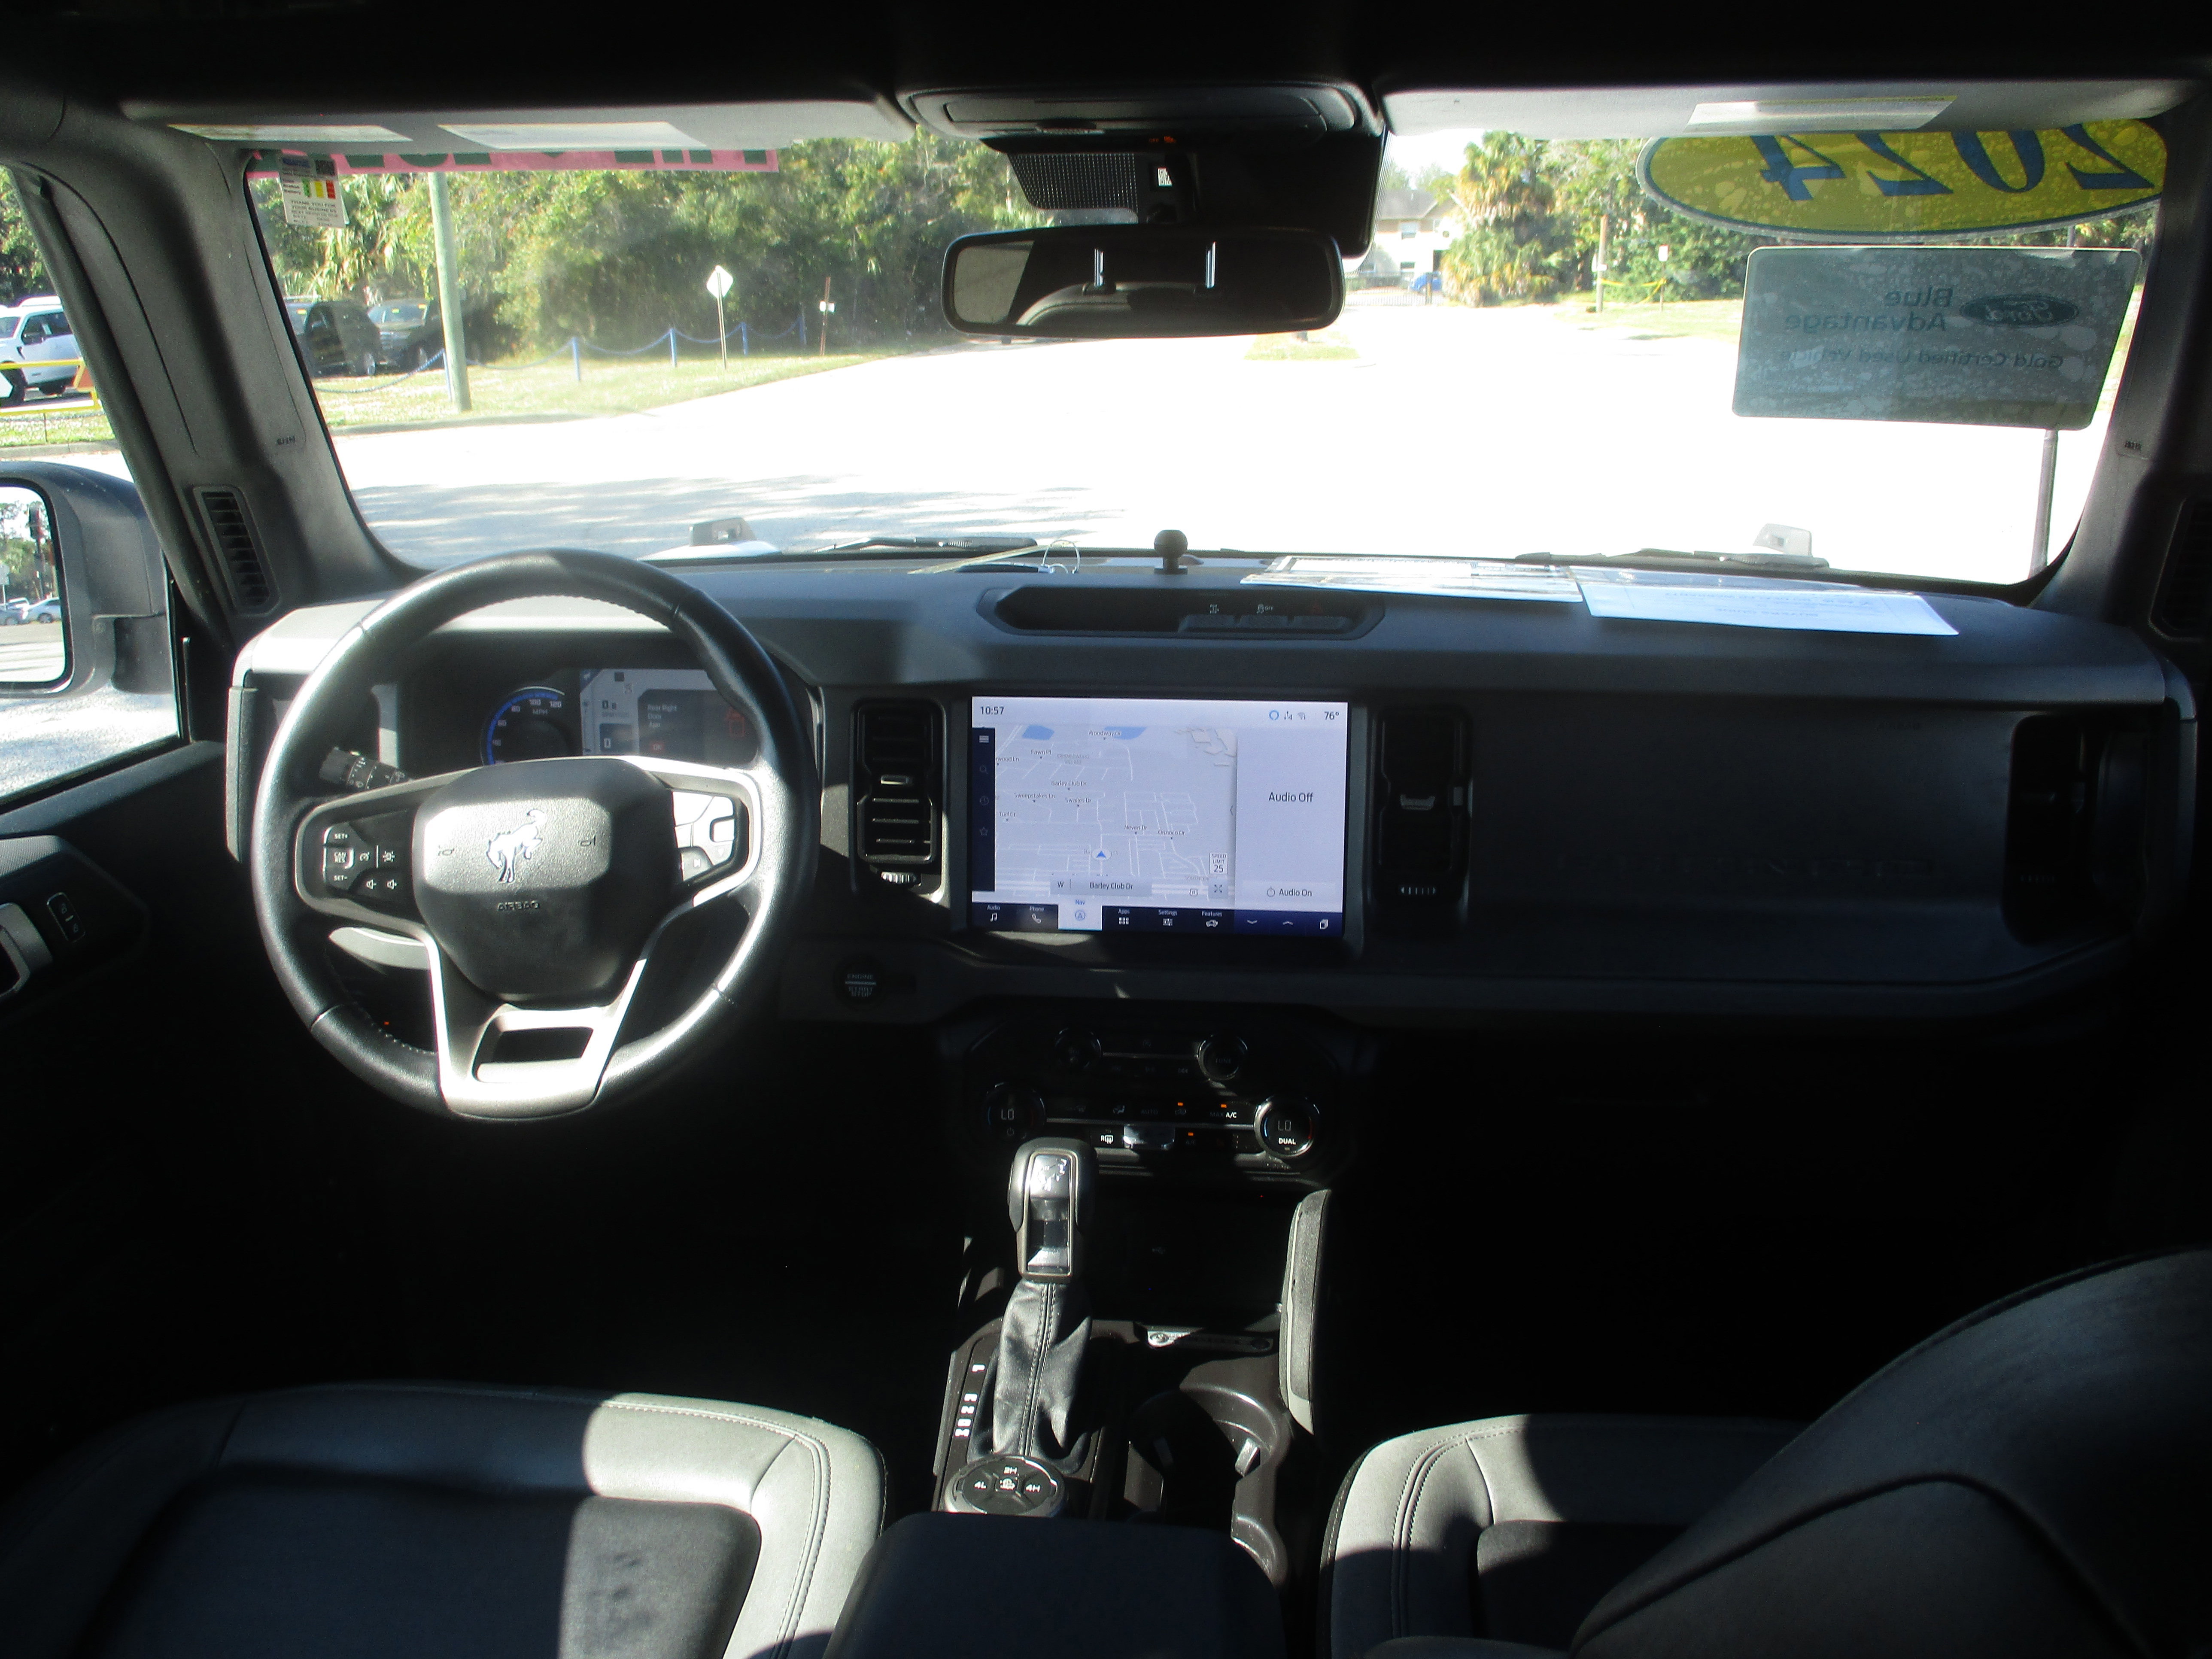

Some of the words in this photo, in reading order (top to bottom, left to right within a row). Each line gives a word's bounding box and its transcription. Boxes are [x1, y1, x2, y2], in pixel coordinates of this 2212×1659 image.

[980, 706, 1004, 715] 10:57
[1268, 792, 1297, 802] Audio
[1298, 792, 1313, 802] Off
[1214, 865, 1224, 873] 25
[1090, 882, 1109, 890] Barley
[1279, 888, 1300, 896] Audio
[497, 900, 539, 911] AIRBAG
[1278, 1137, 1297, 1146] DUAL
[974, 1481, 987, 1490] 4L
[1026, 1484, 1040, 1492] 4H
